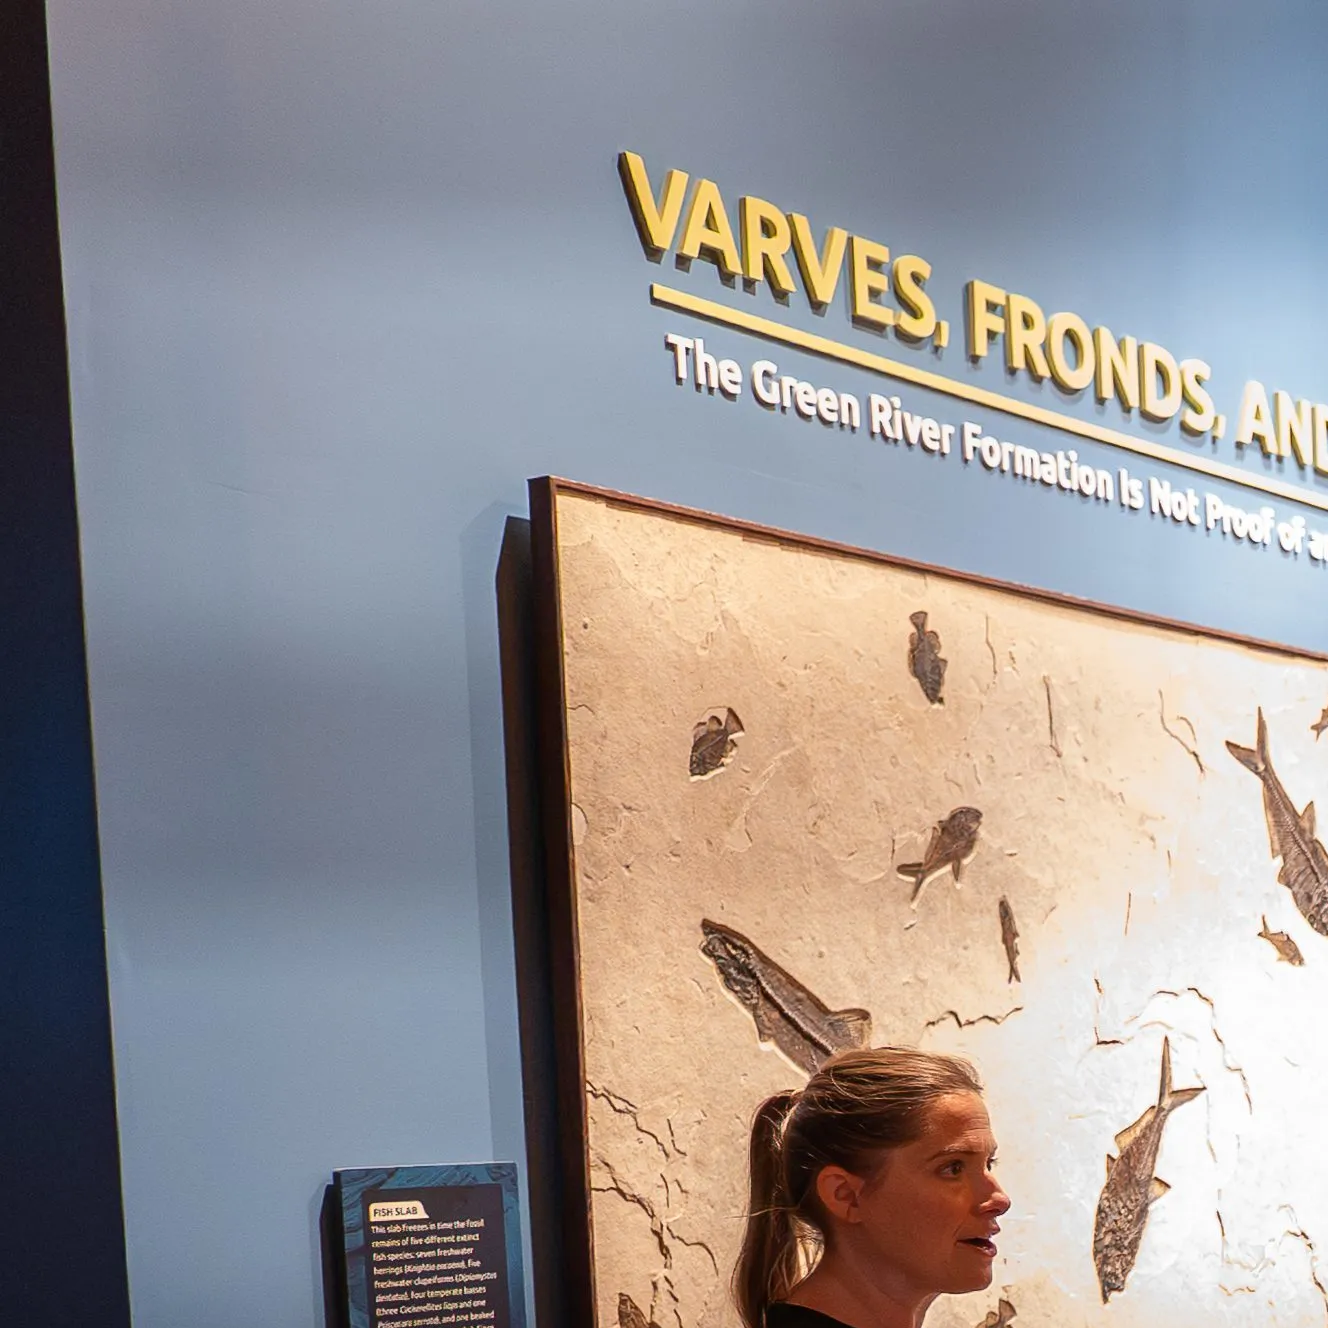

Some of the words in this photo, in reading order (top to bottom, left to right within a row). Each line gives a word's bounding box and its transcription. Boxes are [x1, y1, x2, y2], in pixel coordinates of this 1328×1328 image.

[619, 151, 949, 348] VARVES,
[968, 280, 1225, 437] FRONDS,
[665, 332, 743, 394] The
[752, 360, 860, 427] Green
[870, 393, 954, 454] River
[963, 422, 1113, 500] Formation
[1120, 469, 1143, 509] Is
[1150, 478, 1200, 525] Not
[1206, 494, 1275, 544] Proof
[1276, 516, 1305, 552] of
[374, 1208, 393, 1217] FISH
[395, 1206, 418, 1216] SLAB
[371, 1226, 386, 1234] This
[387, 1224, 402, 1233] slab
[402, 1222, 428, 1232] freezes
[437, 1221, 453, 1230] time
[454, 1220, 466, 1229] the
[466, 1218, 484, 1228] fossil
[372, 1239, 400, 1247] remains
[402, 1237, 409, 1246] of
[411, 1236, 423, 1245] five
[424, 1235, 456, 1244] different
[456, 1234, 480, 1242] extinct
[373, 1252, 386, 1261] fish
[416, 1250, 436, 1258] seven
[437, 1246, 474, 1257] freshwater
[374, 1265, 403, 1276] herrings
[374, 1280, 412, 1289] freshwater
[410, 1291, 426, 1300] four
[427, 1288, 462, 1298] temperate
[464, 1286, 486, 1294] basses
[376, 1307, 398, 1316] (three
[459, 1299, 472, 1308] and
[472, 1299, 486, 1308] one
[442, 1314, 456, 1323] and
[456, 1313, 468, 1322] one
[470, 1310, 495, 1320] beaked
